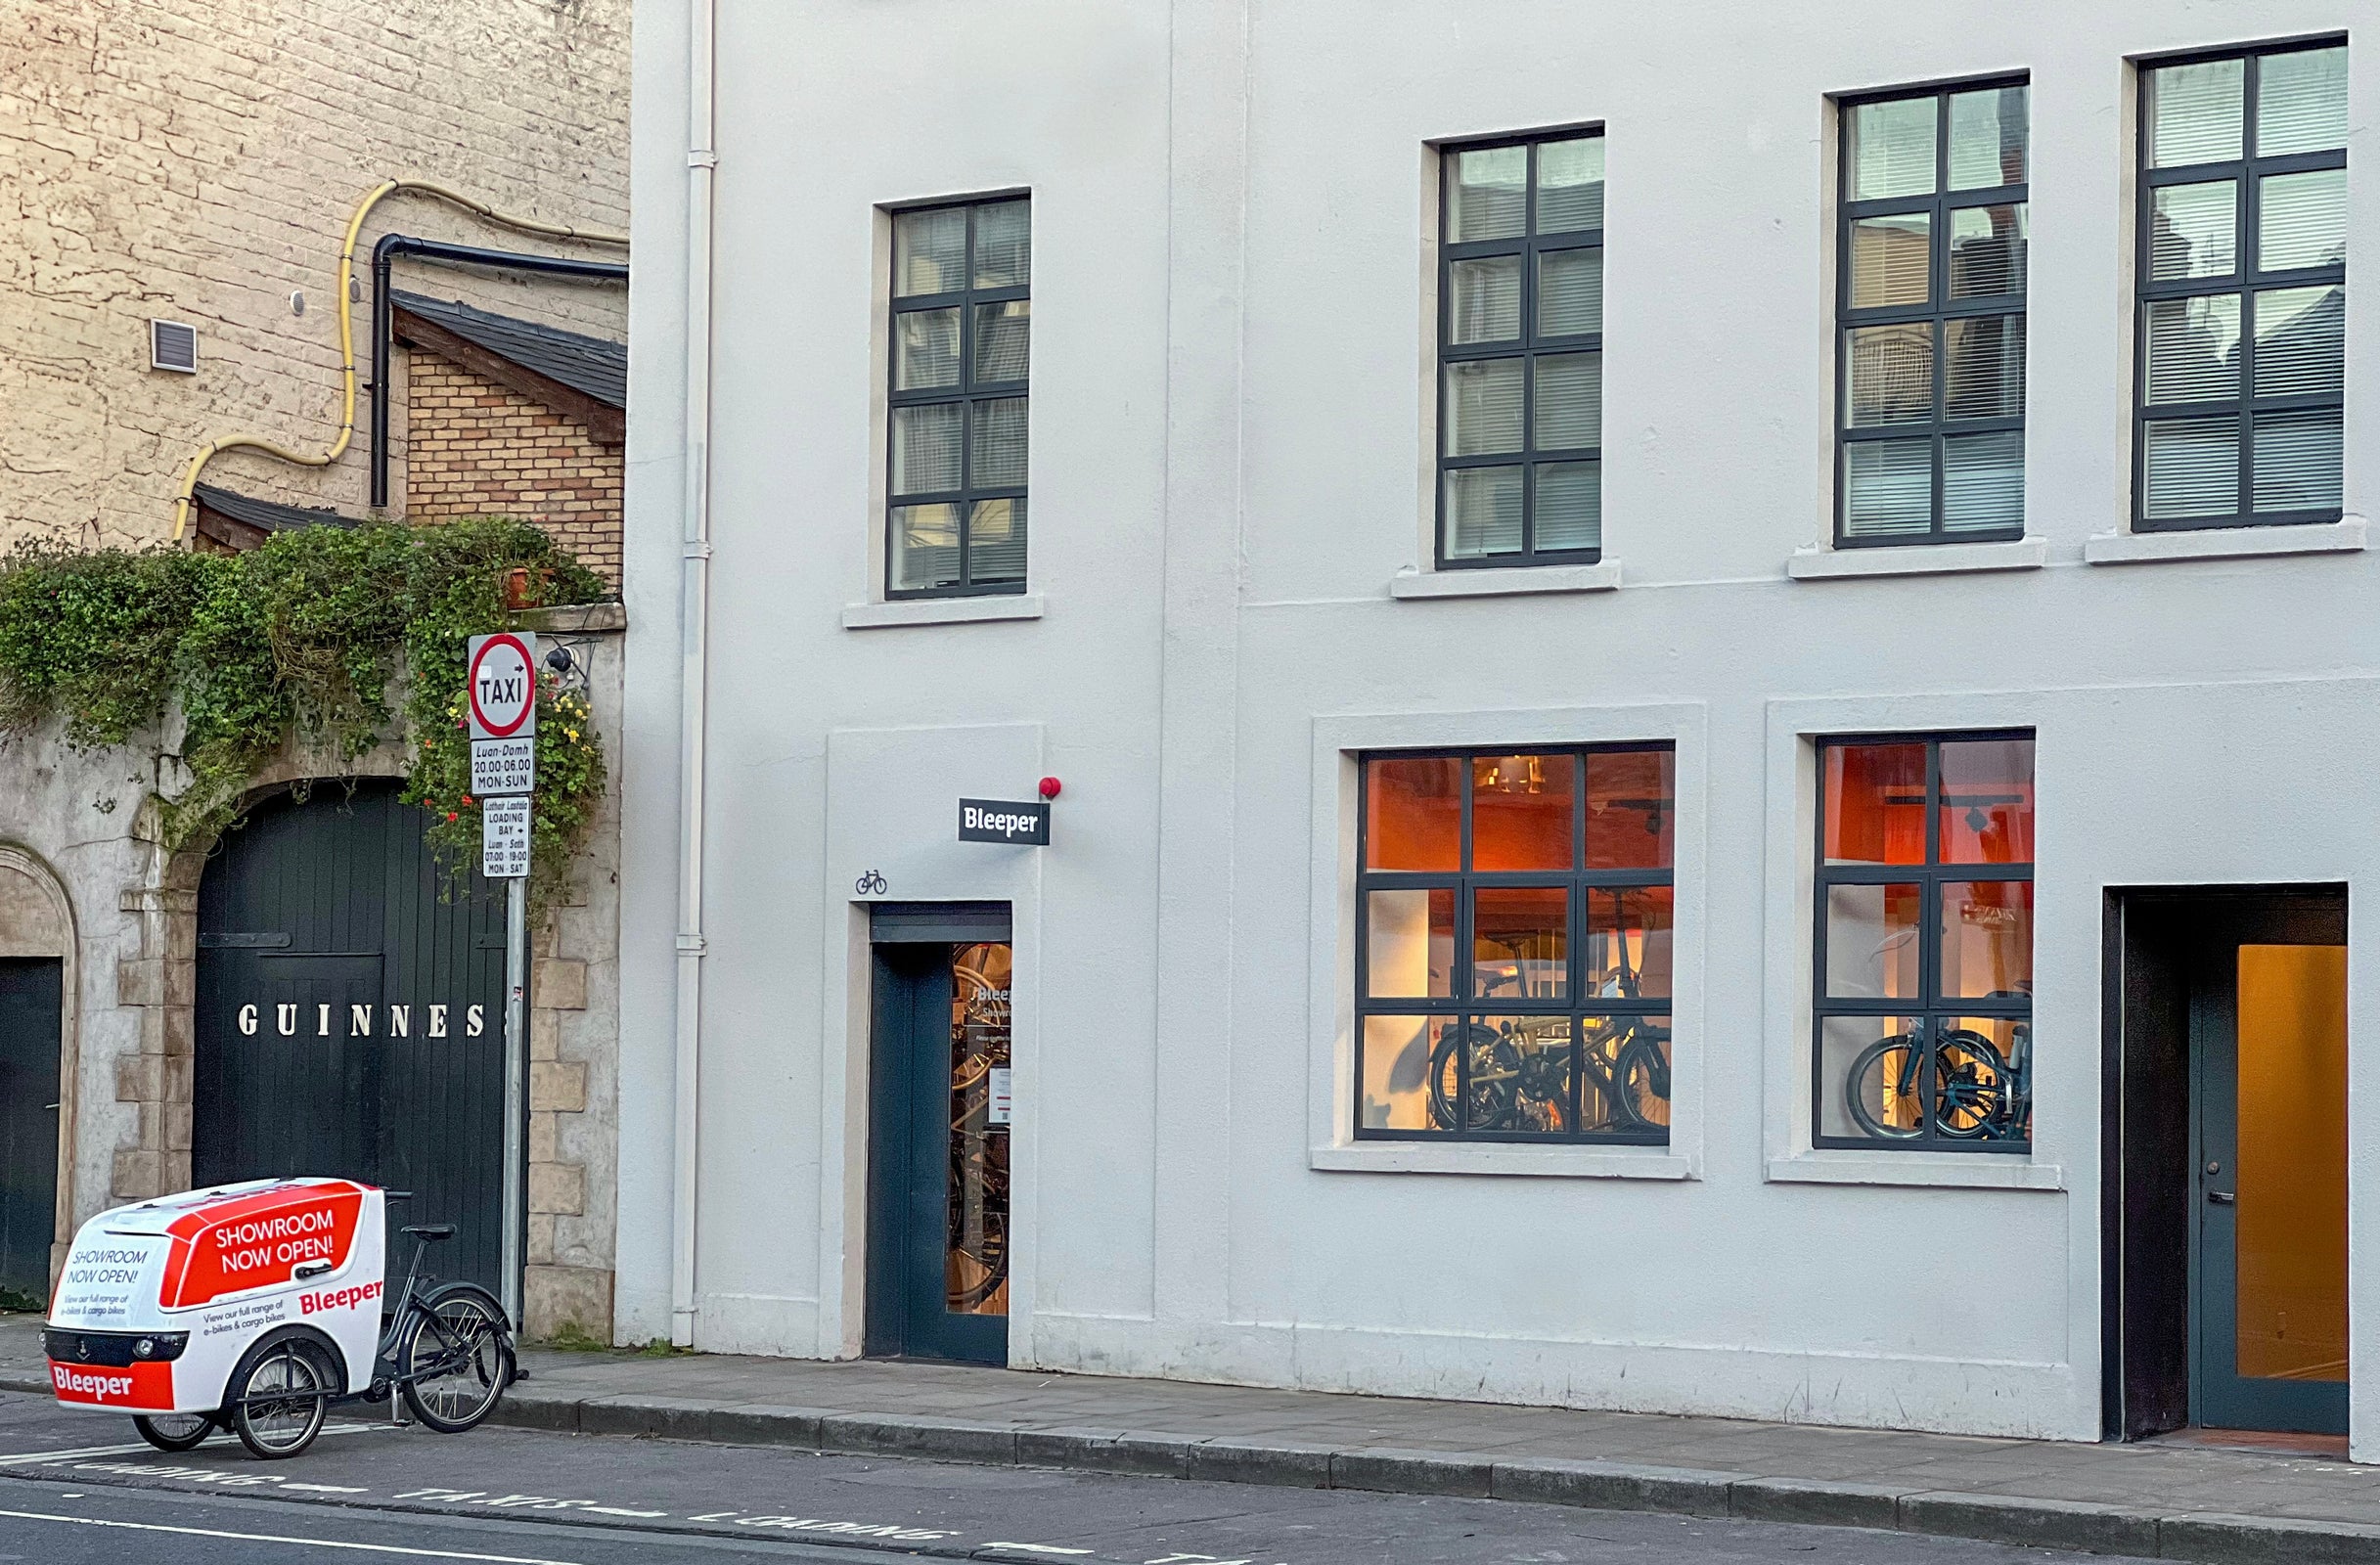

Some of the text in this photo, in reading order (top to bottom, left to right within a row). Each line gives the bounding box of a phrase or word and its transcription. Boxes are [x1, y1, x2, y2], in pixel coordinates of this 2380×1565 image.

[479, 678, 521, 704] TAXI
[478, 775, 527, 788] MON-SUN
[489, 813, 523, 823] LOADING
[964, 807, 1038, 838] Bleeper
[499, 826, 514, 835] BAY
[488, 864, 504, 873] MON
[510, 864, 523, 873] SAT
[978, 986, 1011, 1005] Blee
[238, 1004, 508, 1037] GUINNES
[215, 1209, 334, 1248] SHOWROOM
[72, 1250, 149, 1265] SHOWROOM
[221, 1235, 335, 1274] NOW OPEN!
[67, 1270, 139, 1283] NOW OPEN!
[298, 1280, 383, 1316] Bleeper
[203, 1299, 284, 1323] View our full range of
[203, 1313, 286, 1336] e-bikes & cargo bikes
[53, 1365, 133, 1401] Bleeper
